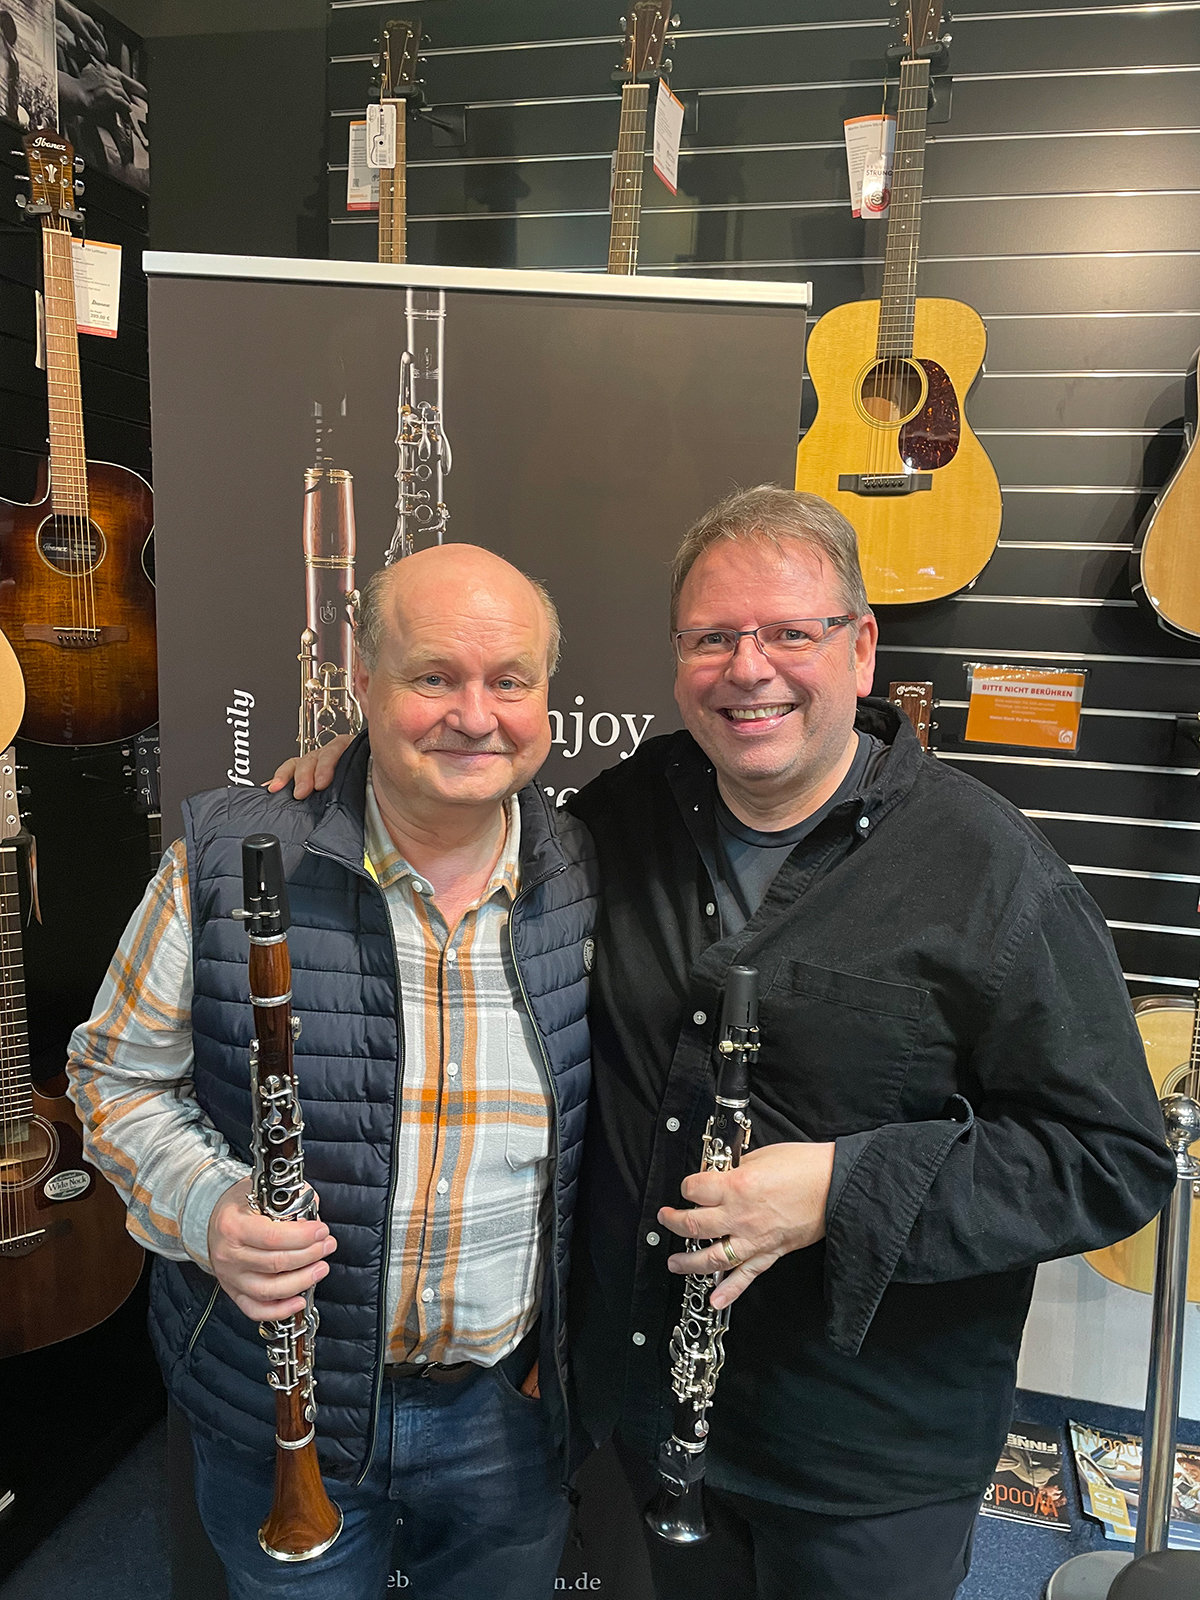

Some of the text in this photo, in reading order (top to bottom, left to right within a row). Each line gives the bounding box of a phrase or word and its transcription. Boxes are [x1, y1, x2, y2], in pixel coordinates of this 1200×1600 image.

[32, 136, 67, 151] Ibanez
[42, 542, 68, 553] Ibanez
[982, 684, 1073, 697] BITTE NICHT BERÜHREN
[225, 688, 255, 787] family
[547, 695, 655, 760] njoy
[1006, 1436, 1058, 1452] FINNE
[1083, 1428, 1143, 1458] Wood
[983, 1483, 1059, 1518] Wood&
[554, 1571, 602, 1591] n.de
